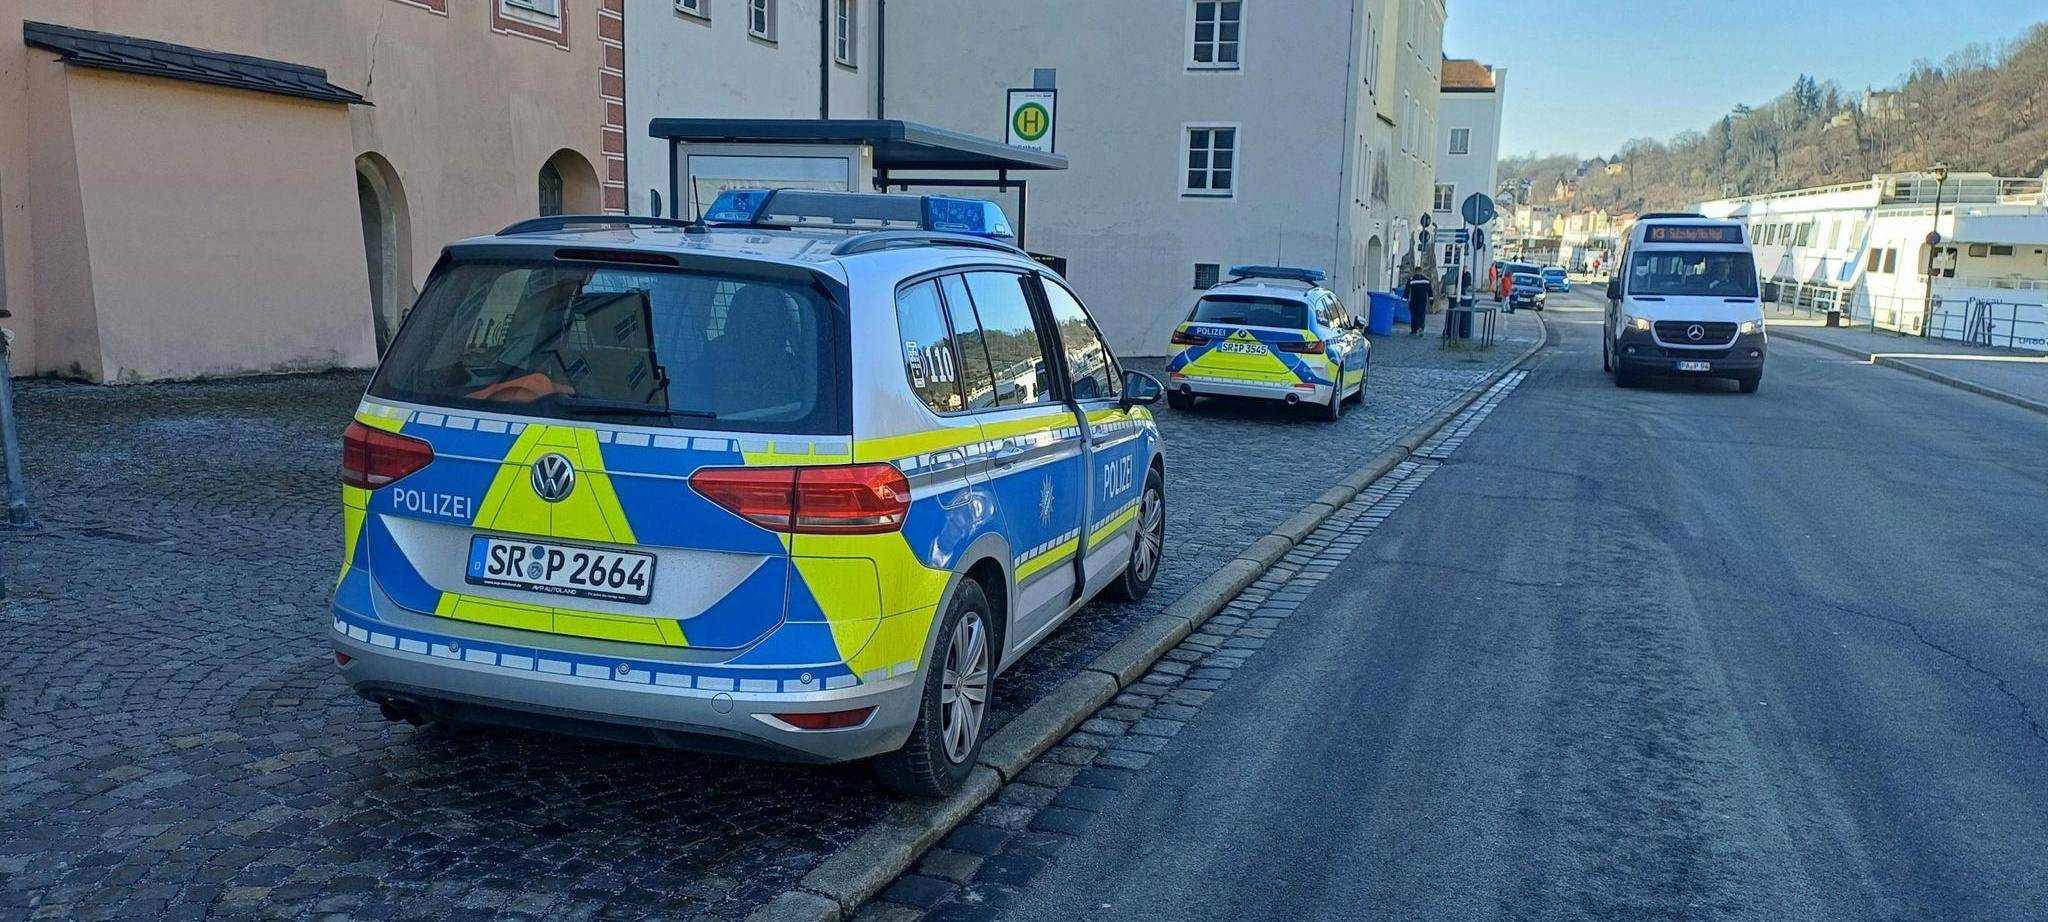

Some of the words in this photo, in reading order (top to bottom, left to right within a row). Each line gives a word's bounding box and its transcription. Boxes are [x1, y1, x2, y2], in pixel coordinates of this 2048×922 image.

[1023, 111, 1038, 133] H
[1196, 327, 1226, 337] POLIZEI
[1222, 343, 1233, 352] SR
[1245, 345, 1267, 355] 3545
[925, 346, 955, 383] 110
[1103, 454, 1133, 501] POLIZEI
[393, 487, 472, 520] POLIZEI
[474, 561, 481, 570] D
[487, 544, 526, 577] SR
[546, 549, 565, 581] P
[569, 553, 646, 591] 2664
[545, 586, 577, 595] AUTOLAND
